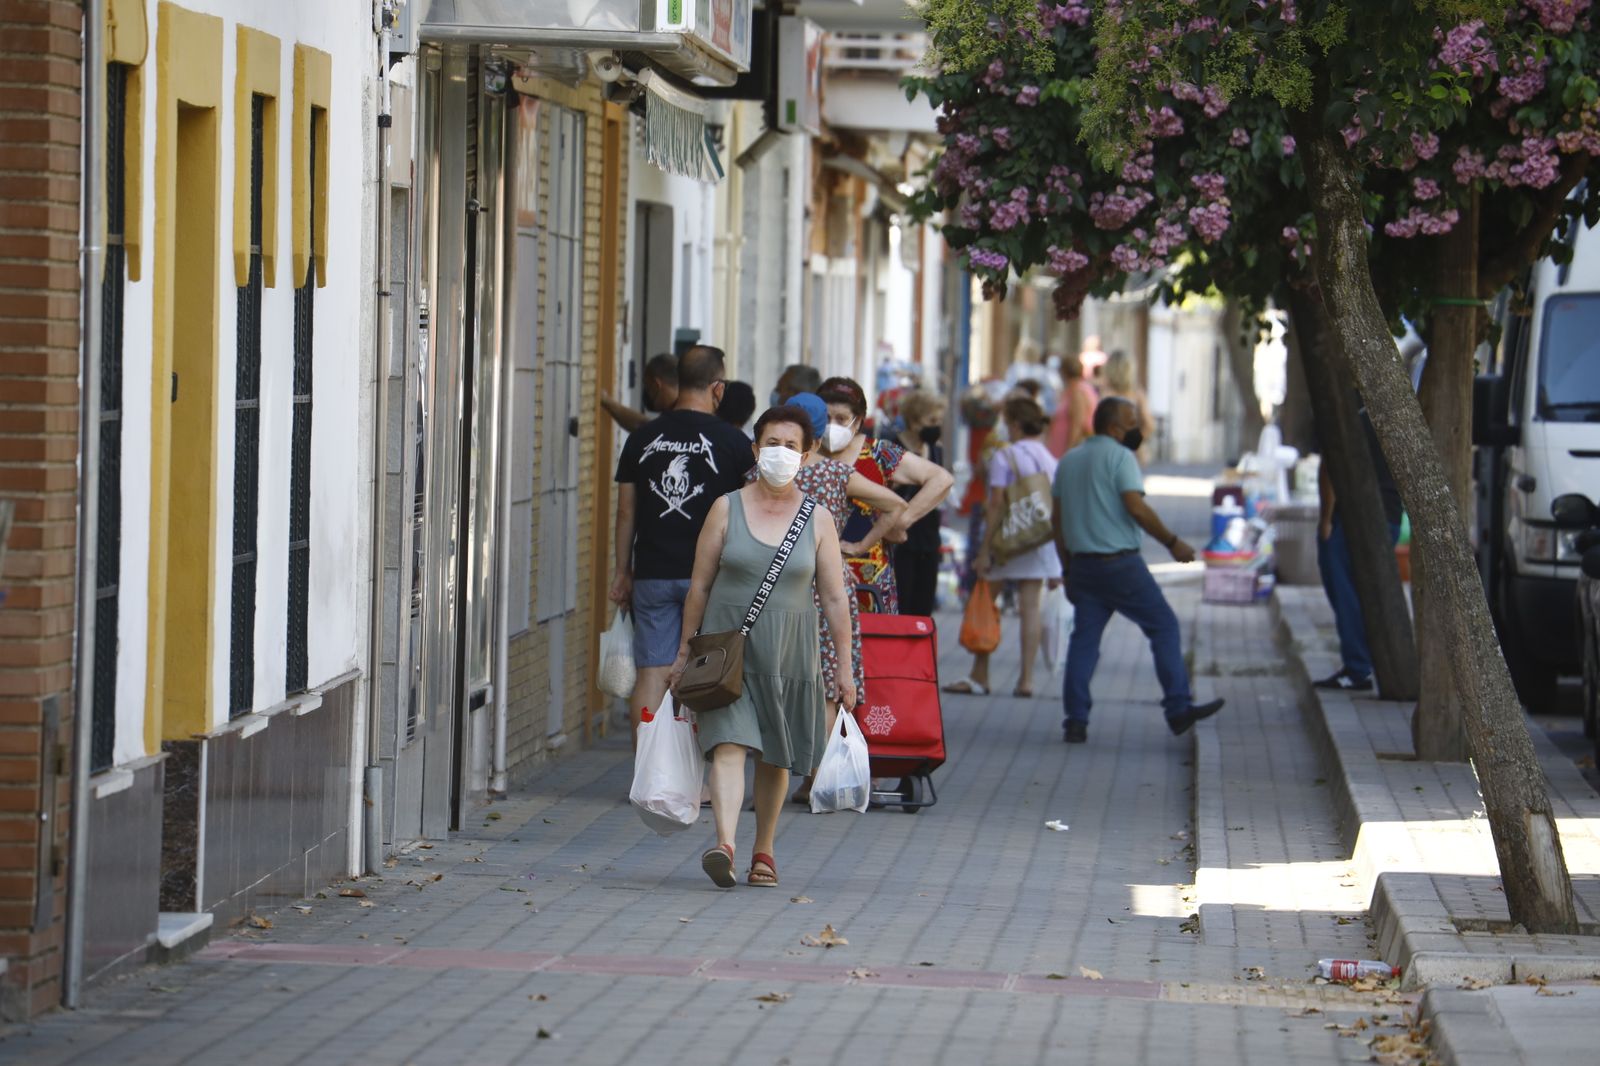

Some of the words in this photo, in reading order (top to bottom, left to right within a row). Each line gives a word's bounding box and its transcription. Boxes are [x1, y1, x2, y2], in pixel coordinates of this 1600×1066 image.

[639, 433, 719, 474] METALLICA
[786, 513, 808, 541] LIFE'S
[801, 500, 815, 516] MY
[766, 541, 794, 582] GETTING
[744, 581, 773, 623] BETTER.
